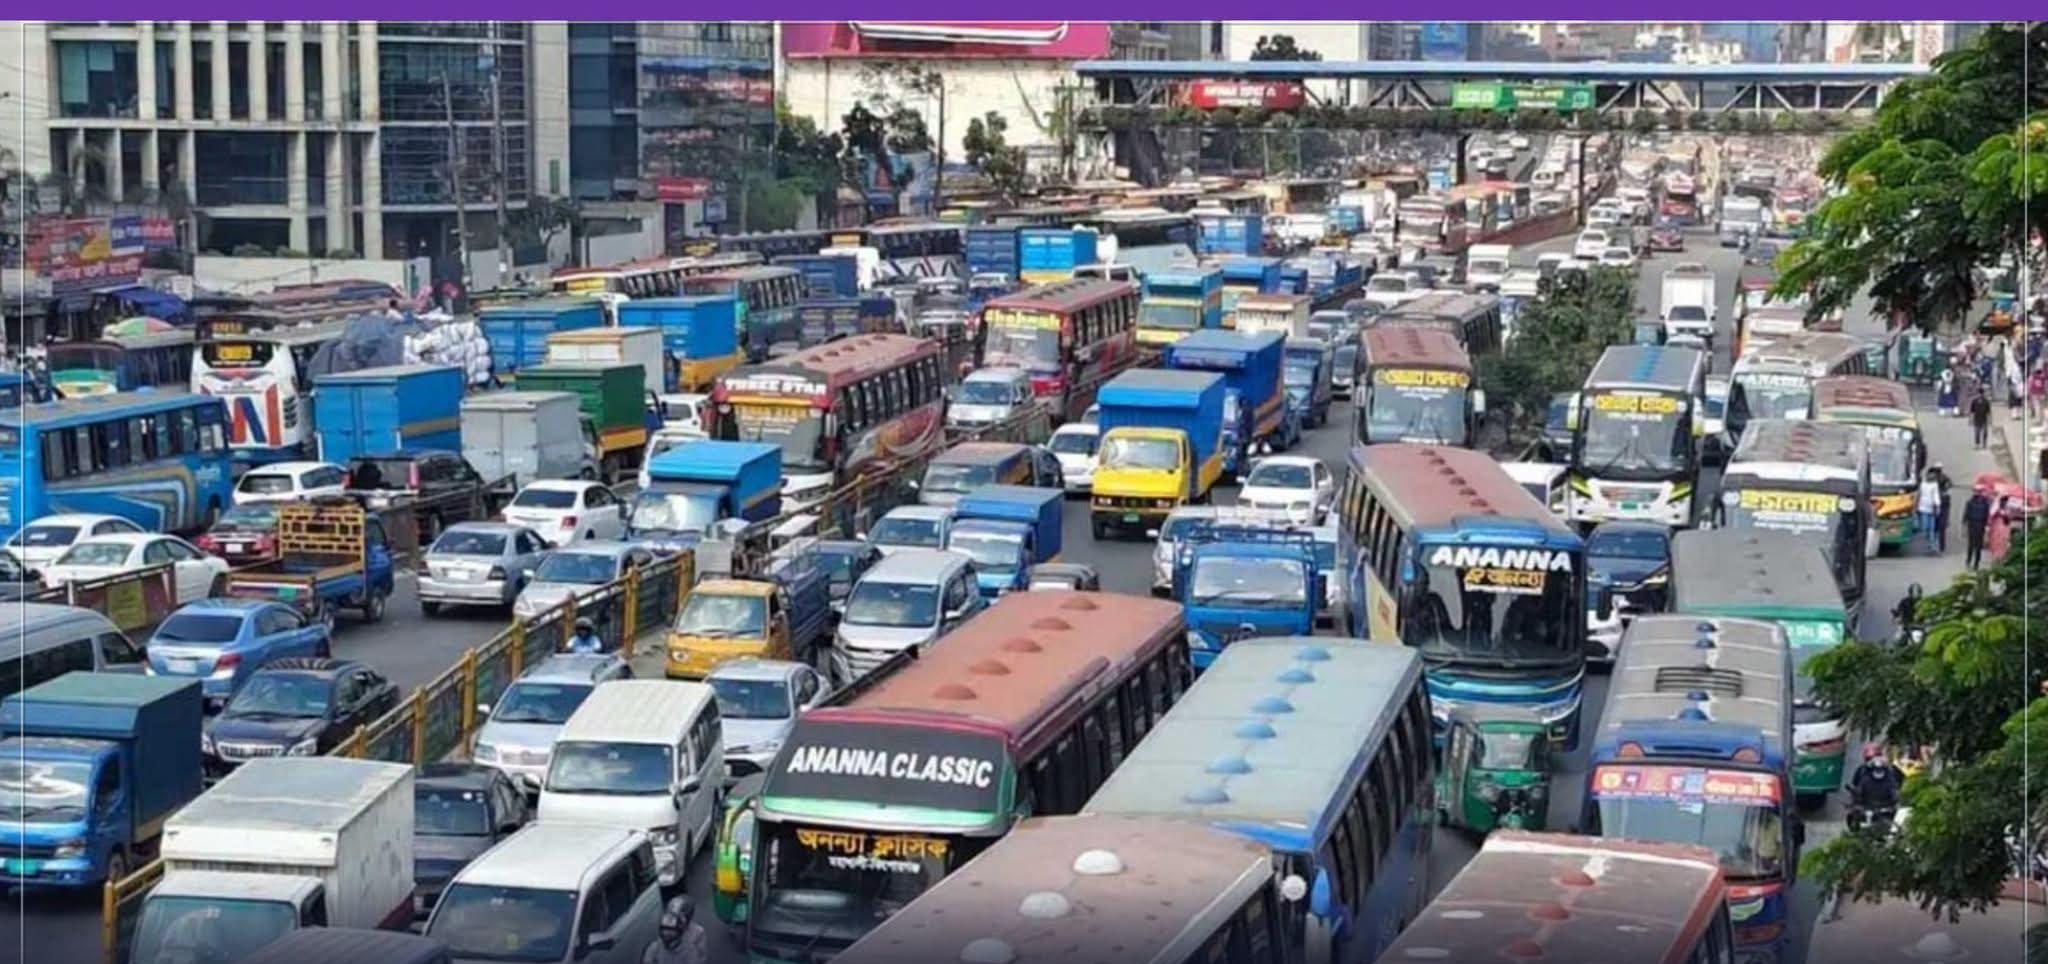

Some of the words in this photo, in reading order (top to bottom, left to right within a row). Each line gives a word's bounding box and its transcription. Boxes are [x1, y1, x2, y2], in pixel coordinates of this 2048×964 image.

[725, 379, 780, 391] THREE
[781, 380, 827, 395] STAR
[1431, 546, 1572, 570] ANANNA
[787, 747, 887, 776] ANANNA
[890, 753, 994, 788] CLASSIC
[797, 829, 866, 855] অনন্যা
